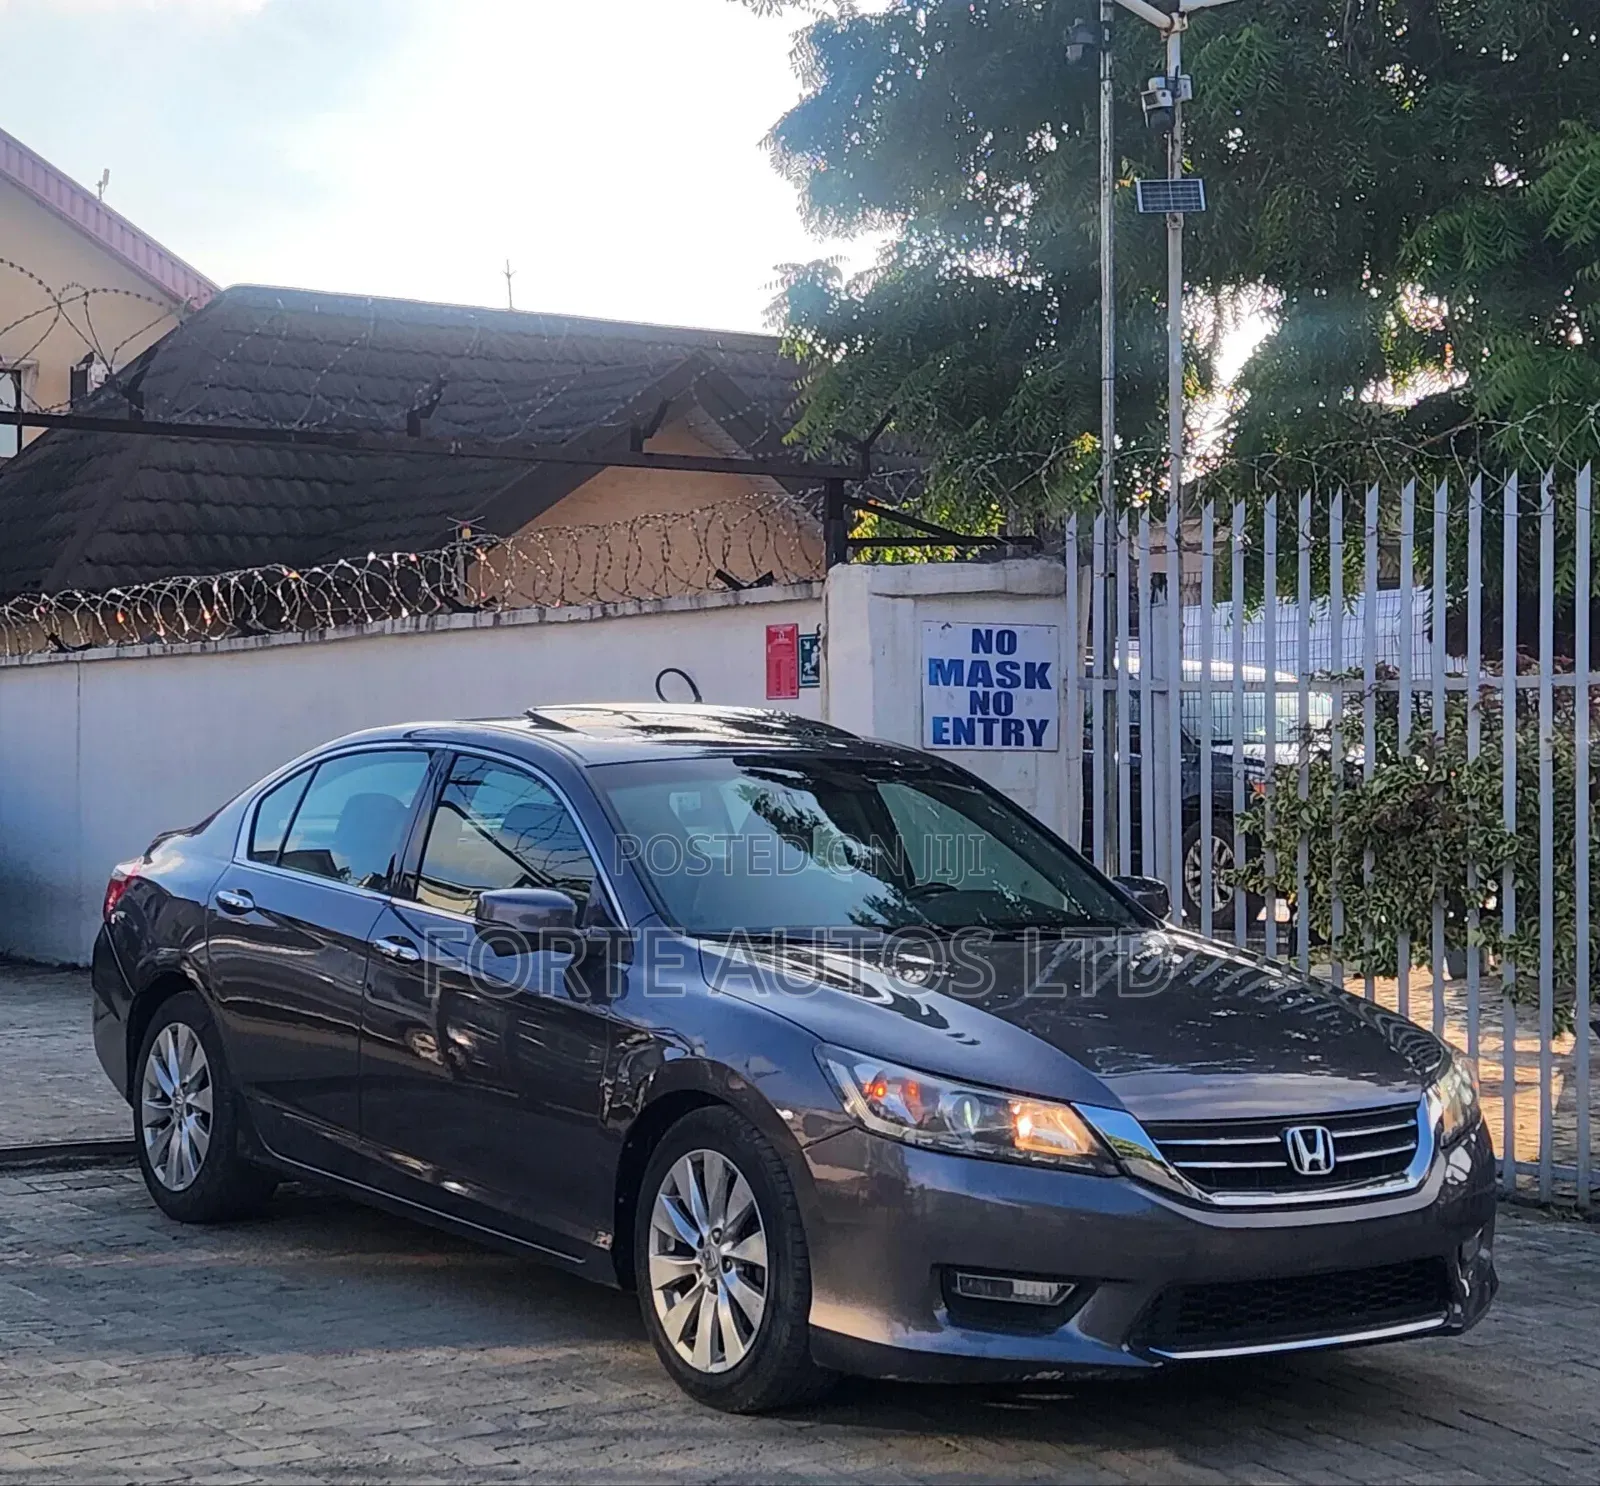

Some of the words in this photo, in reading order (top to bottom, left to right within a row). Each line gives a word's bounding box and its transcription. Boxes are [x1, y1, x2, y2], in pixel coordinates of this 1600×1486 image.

[971, 628, 1017, 655] NO
[928, 658, 1052, 690] MASK
[969, 690, 1013, 716] NO
[932, 716, 1050, 747] ENTRY
